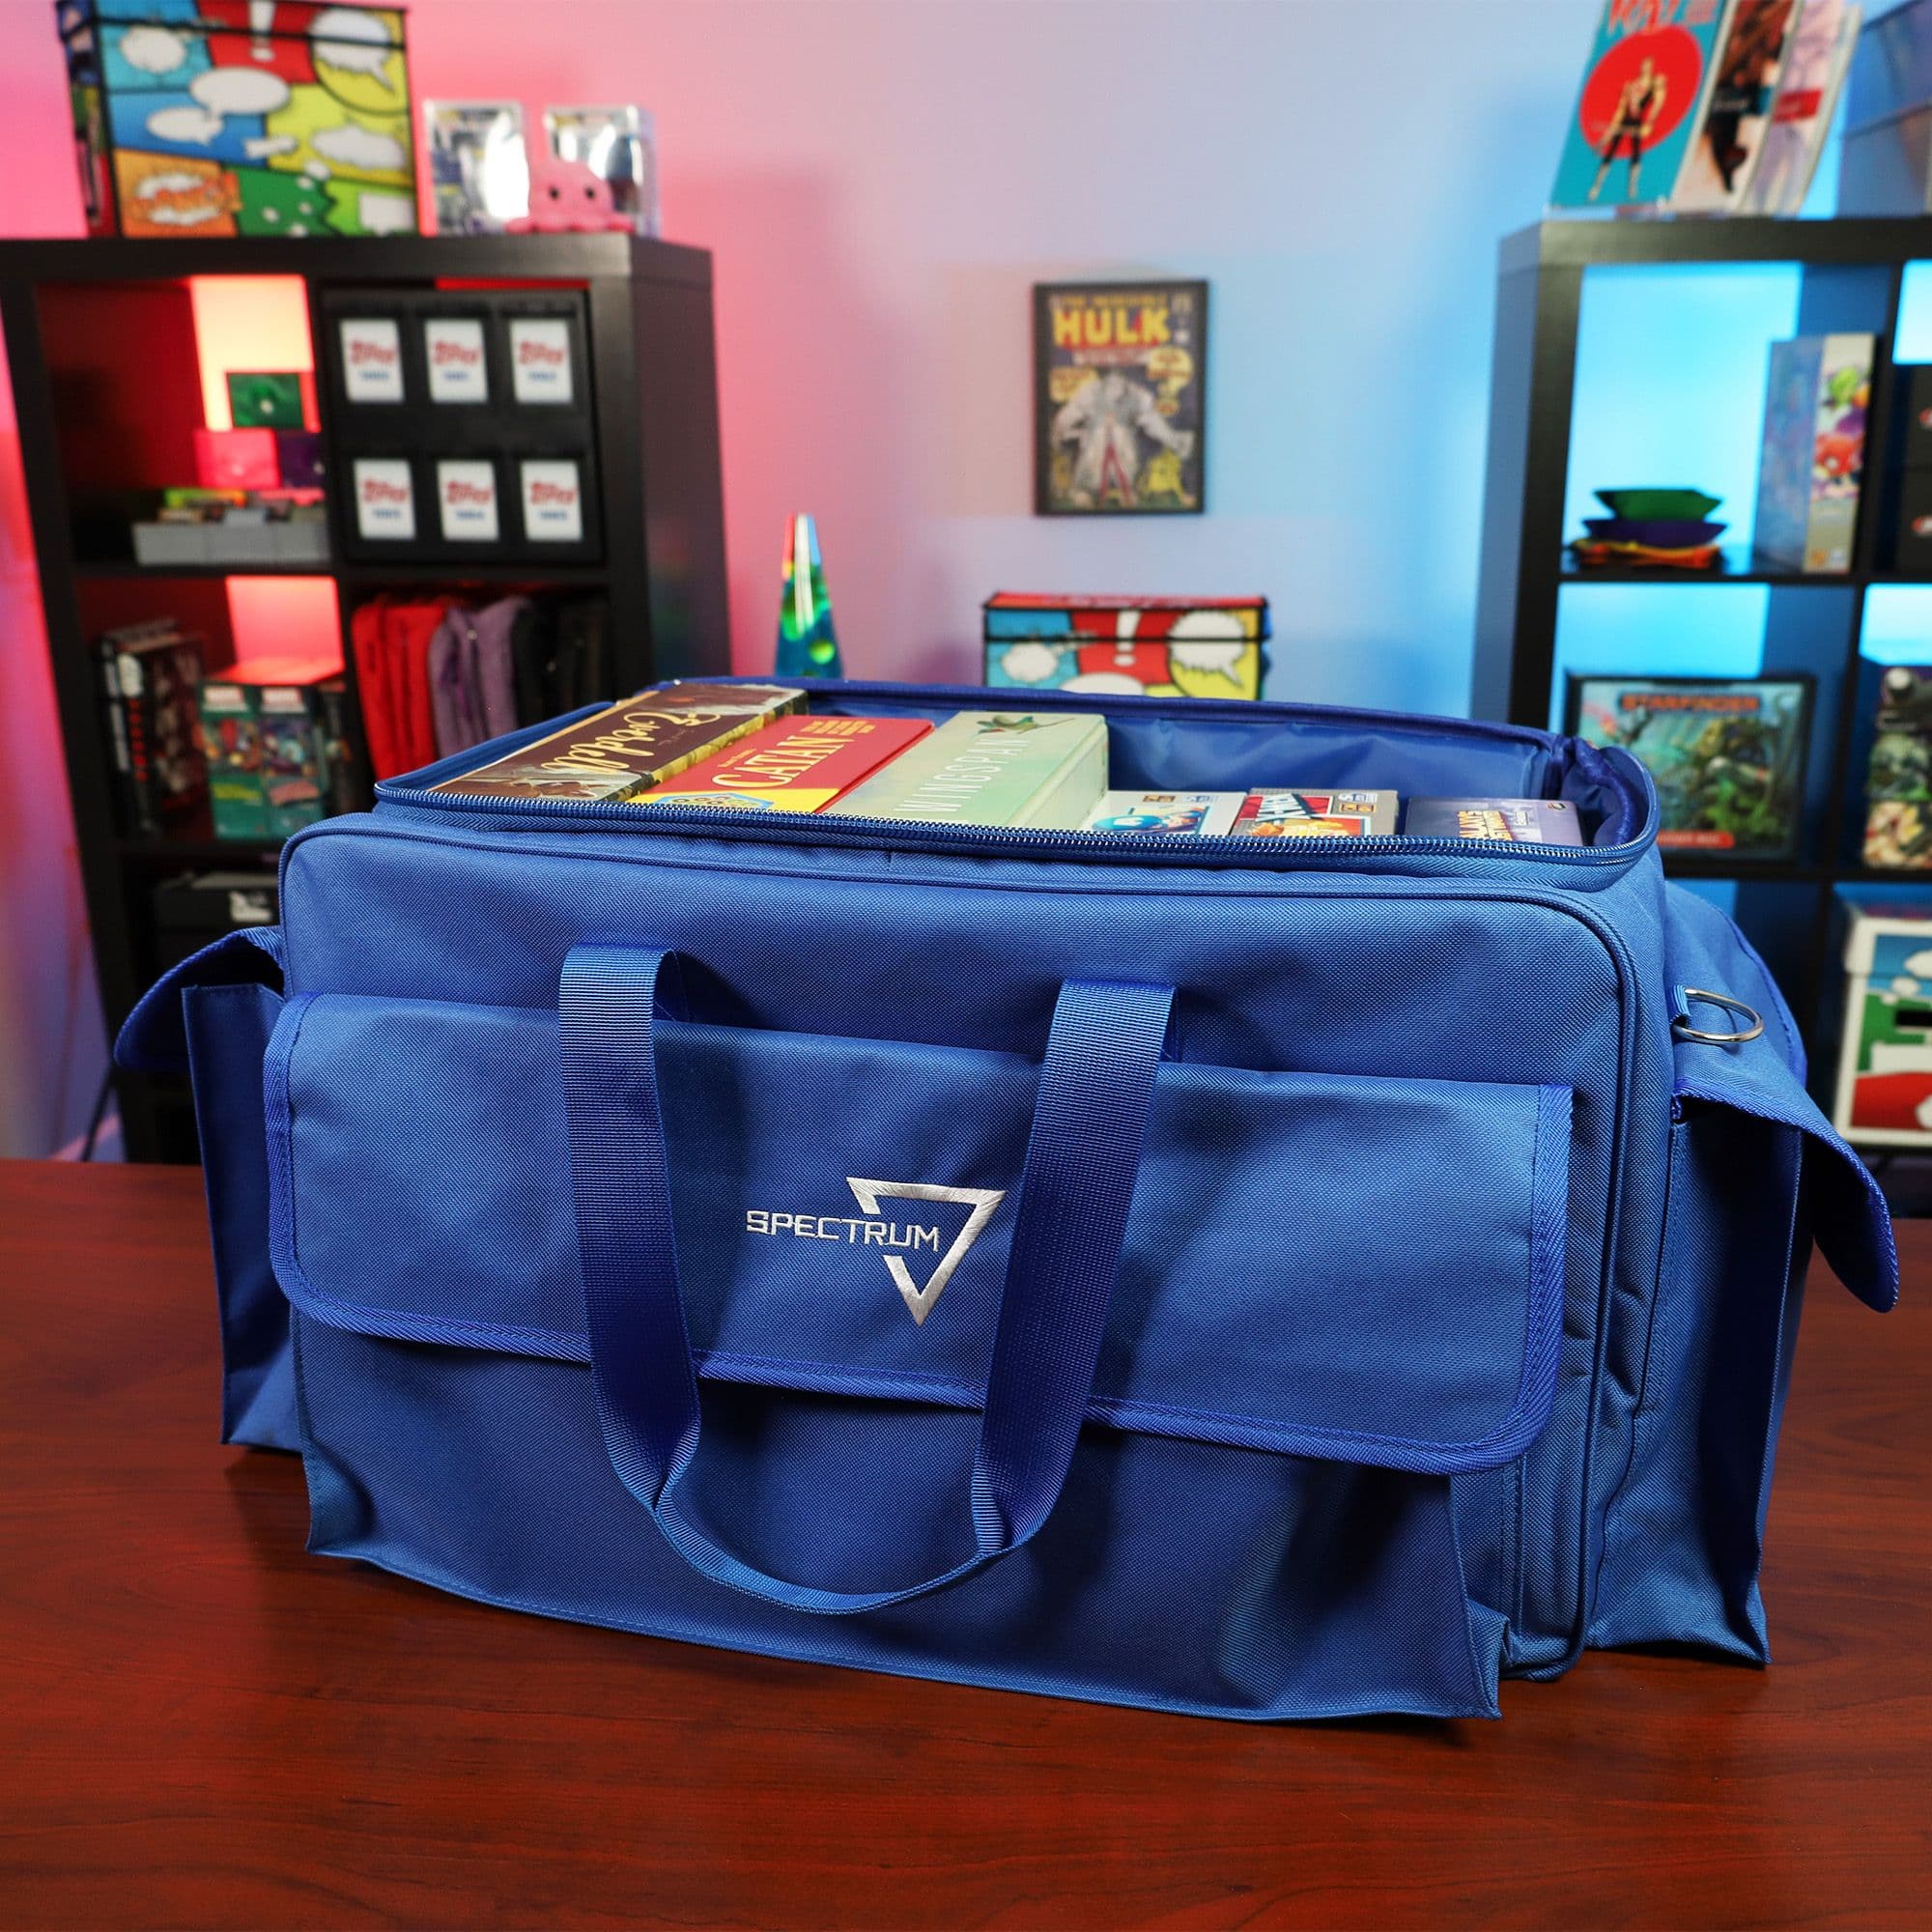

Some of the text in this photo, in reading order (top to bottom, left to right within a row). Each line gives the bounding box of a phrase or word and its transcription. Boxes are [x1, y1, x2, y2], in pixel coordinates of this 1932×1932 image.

[1053, 307, 1172, 348] HULK
[540, 711, 722, 775] Everdell
[711, 735, 855, 788] CATAN
[893, 738, 1032, 812] WINGSPAN
[746, 1209, 940, 1253] SPECTRUM
